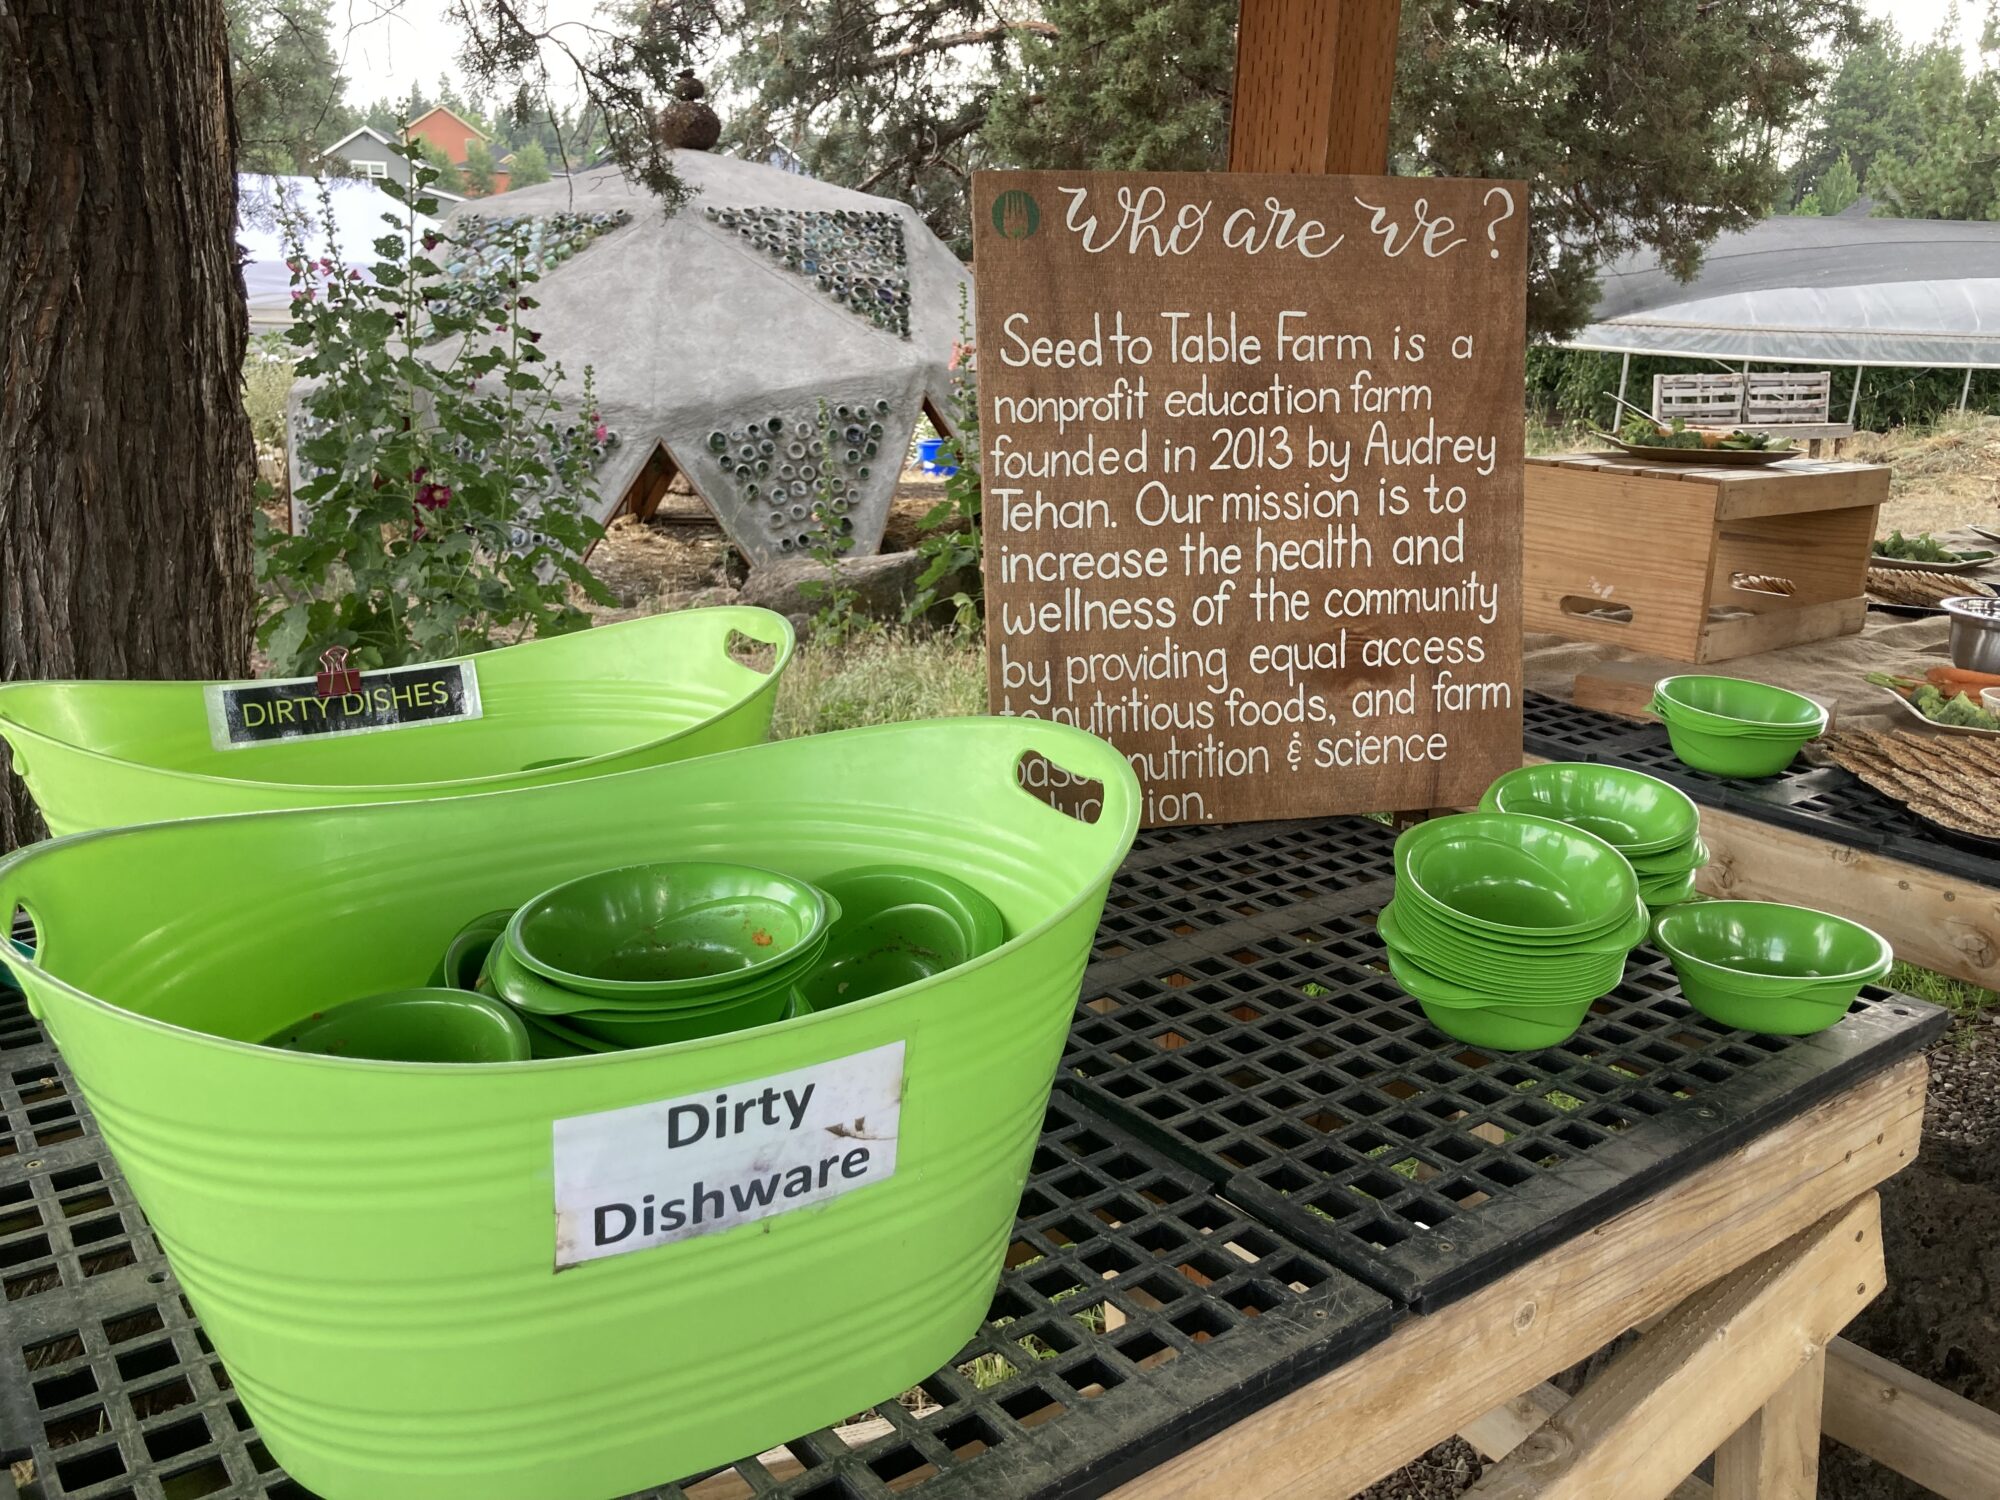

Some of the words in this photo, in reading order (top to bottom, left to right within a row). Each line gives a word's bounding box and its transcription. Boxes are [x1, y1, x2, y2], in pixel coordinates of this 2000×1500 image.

[1058, 186, 1212, 258] Who
[1223, 196, 1345, 258] are
[1000, 312, 1104, 369] Seed
[1109, 312, 1153, 366] to
[1161, 311, 1261, 366] Table
[1277, 311, 1371, 362] Farm
[1393, 326, 1425, 362] is
[1452, 334, 1473, 359] a
[995, 377, 1149, 435] nonprofit
[1165, 373, 1341, 418] education
[1351, 370, 1432, 413] farm
[990, 429, 1147, 479] founded
[1164, 439, 1196, 473] in
[1210, 426, 1291, 473] 2013
[1308, 426, 1350, 483] by
[1364, 418, 1497, 476] Audrey
[991, 488, 1117, 533] Tehan.
[1136, 480, 1213, 527] Our
[1222, 477, 1359, 523] mission
[1379, 475, 1409, 517] is
[1424, 475, 1467, 514] to
[1001, 546, 1168, 583] increase
[1180, 533, 1242, 576] the
[1255, 526, 1371, 573] health
[1393, 519, 1465, 565] and
[1003, 589, 1176, 636] wellness
[1193, 579, 1236, 626] of
[1250, 578, 1310, 623] the
[1324, 571, 1498, 624] community
[1002, 644, 1051, 705] by
[1066, 637, 1228, 700] providing
[1249, 628, 1346, 672] equal
[1363, 635, 1484, 668] access
[242, 696, 330, 727] DIRTY
[342, 680, 448, 716] DISHES
[1053, 691, 1213, 733] nutritious
[1225, 683, 1336, 727] foods,
[1352, 676, 1415, 719] and
[1432, 670, 1510, 713] farm
[1128, 738, 1269, 780] nutrition
[1314, 730, 1447, 768] science
[668, 1083, 815, 1149] Dirty
[594, 1146, 870, 1246] Dishware
